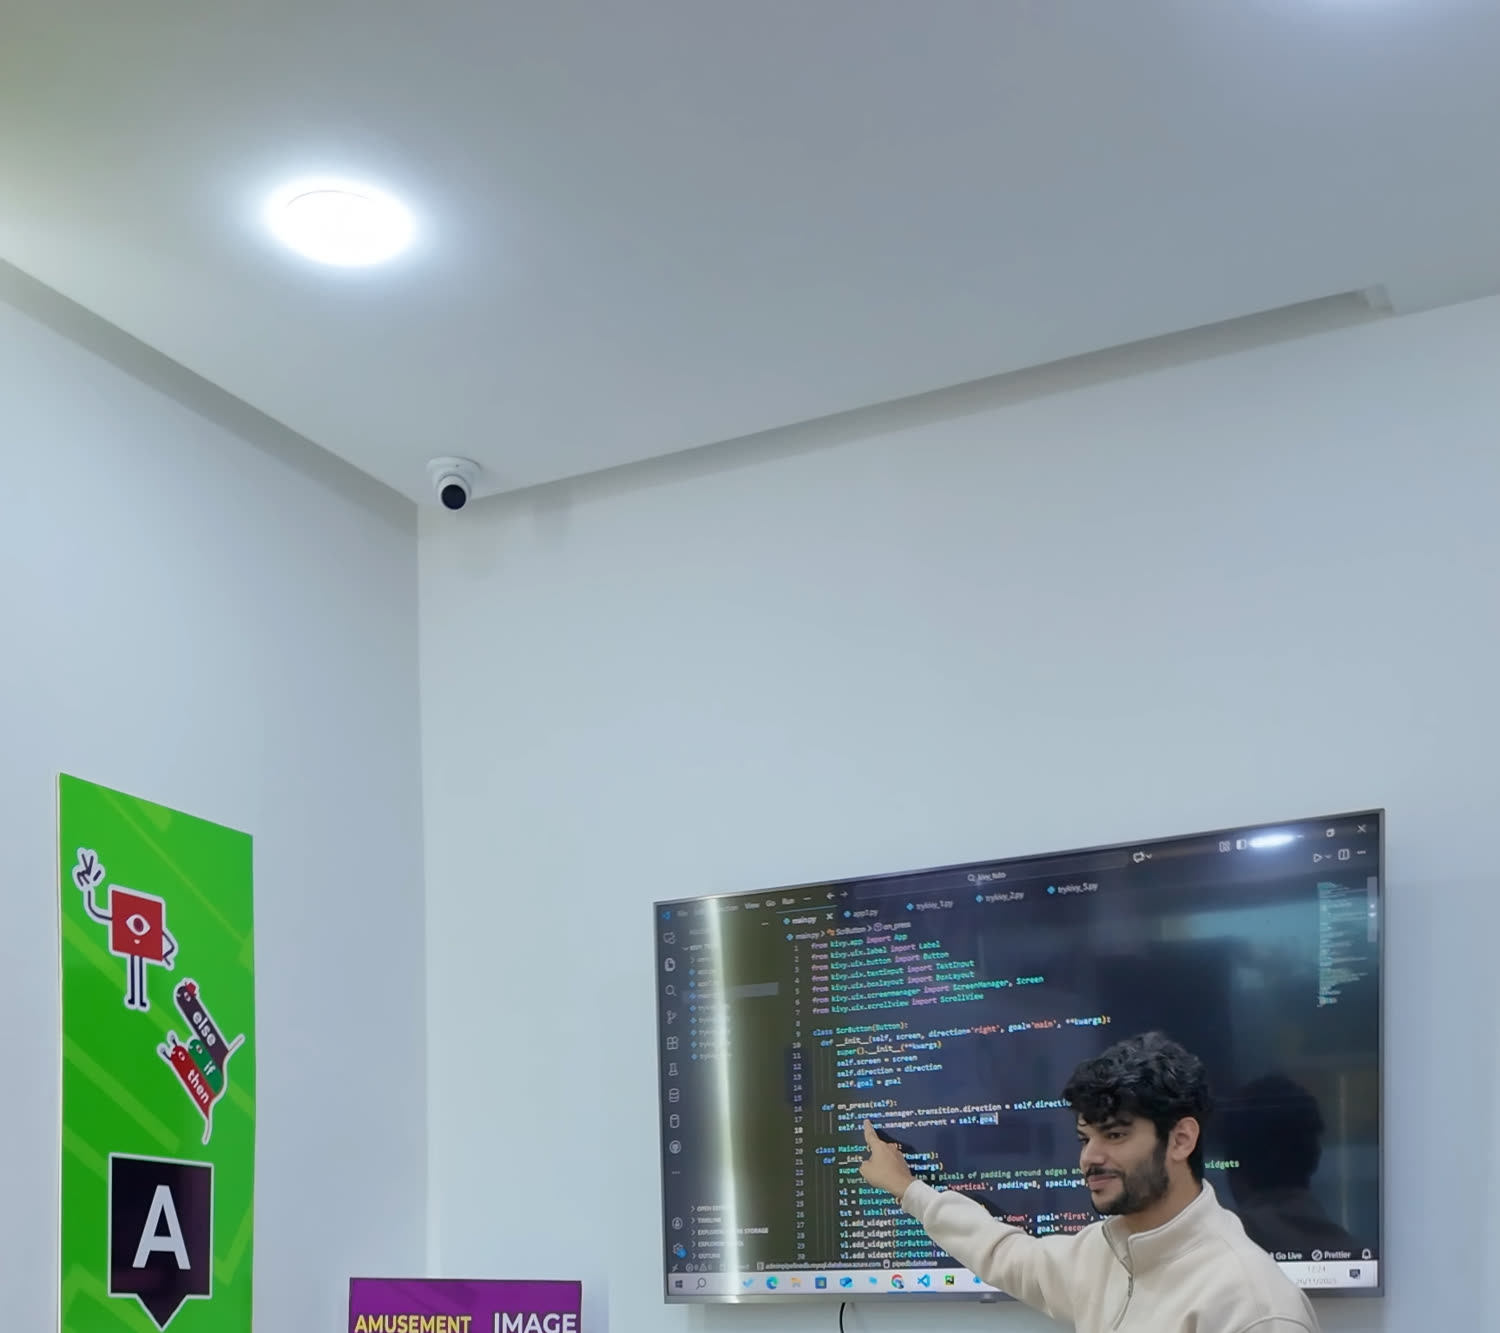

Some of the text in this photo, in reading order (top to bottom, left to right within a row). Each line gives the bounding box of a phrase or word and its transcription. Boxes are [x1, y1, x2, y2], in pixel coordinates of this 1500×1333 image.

[1058, 882, 1098, 894] trykivy_5.py
[985, 891, 1024, 903] trykivy_2.py
[811, 942, 828, 950] from
[830, 938, 864, 949] kivy.app
[866, 934, 892, 944] import
[894, 933, 908, 942] App
[811, 953, 828, 961] from
[830, 947, 887, 960] kivy.uix.label
[890, 943, 916, 953] import
[919, 940, 941, 950] Label
[812, 964, 828, 972] from
[830, 958, 892, 970] kivy.uix.button
[894, 954, 920, 964] import
[923, 952, 950, 960] Button
[812, 974, 829, 982] from
[831, 966, 904, 982] kivy.uix.textinput
[908, 964, 932, 974] import
[936, 959, 975, 970] TextInput
[831, 978, 904, 992] kivy.uix.boxlayout
[908, 974, 933, 984] import
[936, 970, 975, 982] BoxLayout
[812, 996, 830, 1004] from
[832, 988, 921, 1003] kivy.uix.screenmanager
[924, 984, 950, 994] import
[952, 979, 1013, 992] ScreenManager,
[1016, 976, 1044, 986] Screen
[832, 1000, 909, 1014] kivy.uix.scrollview
[912, 996, 938, 1006] import
[940, 992, 984, 1004] ScrollView
[193, 1011, 216, 1046] else
[813, 1028, 832, 1036] class
[836, 1022, 908, 1035] ScrButton(Button):
[820, 1039, 834, 1047] def
[836, 1034, 893, 1047] __init__(self,
[896, 1032, 925, 1041] screen,
[928, 1024, 1005, 1038] direction='right',
[1008, 1019, 1062, 1033] goal='main',
[204, 1060, 216, 1076] if
[836, 1056, 882, 1068] self.screen
[892, 1055, 918, 1063] screen
[836, 1066, 894, 1078] self.direction
[904, 1063, 943, 1072] direction
[188, 1069, 210, 1104] then
[837, 1078, 874, 1090] self.goal
[884, 1076, 902, 1087] goal
[822, 1103, 834, 1111] def
[838, 1099, 898, 1112] on_press(self):
[1014, 1098, 1072, 1110] self.directio
[838, 1118, 948, 1132] self.sen.manager.current
[959, 1114, 997, 1125] self.goal
[823, 1157, 836, 1165] def
[838, 1156, 863, 1164] __init
[903, 1152, 939, 1160] kwargs):
[839, 1166, 860, 1174] super
[907, 1162, 944, 1171] kwargs)
[938, 1171, 964, 1181] pixels
[968, 1171, 977, 1180] of
[980, 1169, 1012, 1180] padding
[1014, 1168, 1042, 1177] around
[1044, 1168, 1068, 1178] edges
[1204, 1160, 1240, 1170] widgets
[858, 1187, 890, 1196] BoxLayo
[932, 1182, 993, 1192] ion='vertical',
[858, 1198, 901, 1206] BoxLayout(
[840, 1218, 923, 1228] vl.add_widget(ScrBut
[994, 1214, 1032, 1223] ='down',
[1036, 1212, 1094, 1223] goal='first',
[863, 1208, 904, 1217] Label(text
[132, 1184, 191, 1270] A
[840, 1229, 928, 1239] vl.add_widget(ScrButt
[1036, 1224, 1086, 1235] goal='seco
[840, 1240, 937, 1250] vl.add_widget(ScrButton
[1275, 1251, 1302, 1260] Go Live
[1324, 1250, 1351, 1260] Prettier
[354, 1315, 472, 1333] AMUSEMENT
